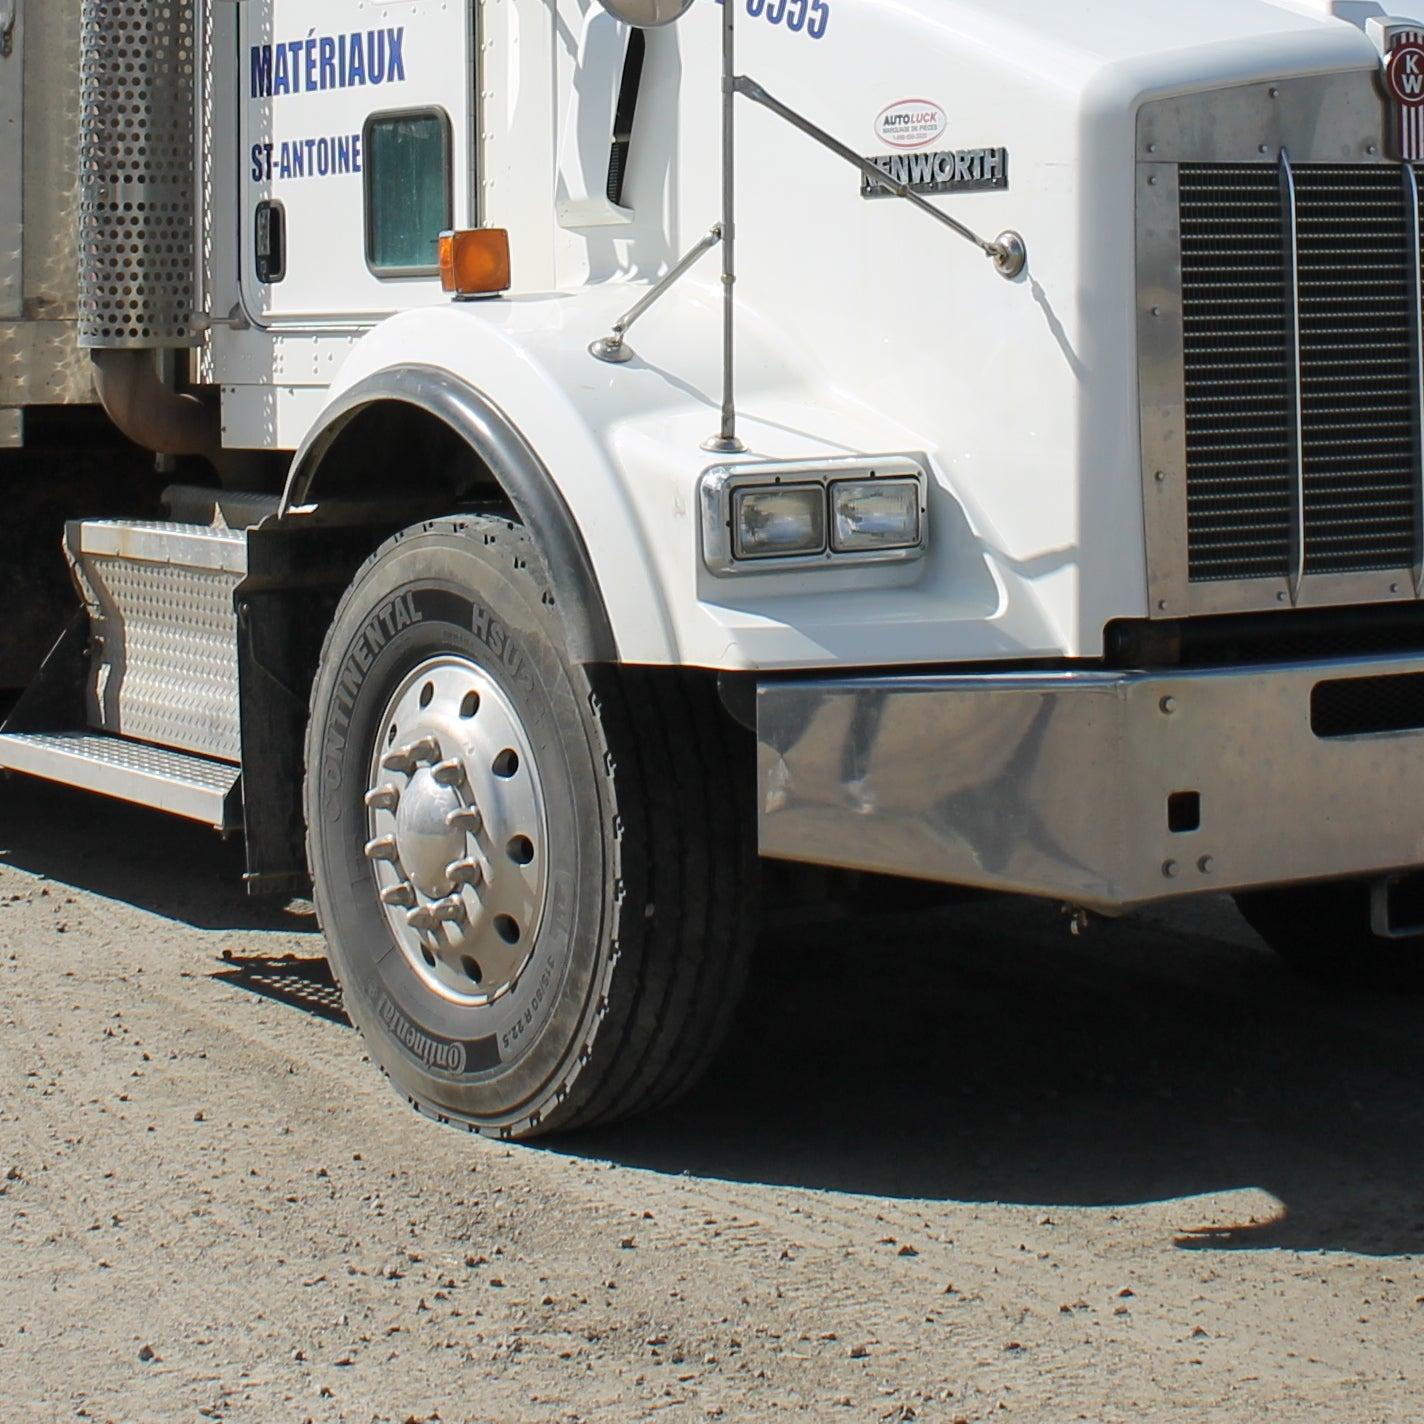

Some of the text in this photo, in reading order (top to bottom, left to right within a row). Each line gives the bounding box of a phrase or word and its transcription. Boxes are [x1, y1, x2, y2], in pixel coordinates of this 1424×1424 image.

[250, 27, 406, 98] MATÉRIAUX
[882, 111, 938, 126] AUTOLUCK
[250, 133, 362, 182] ST-ANTOINE
